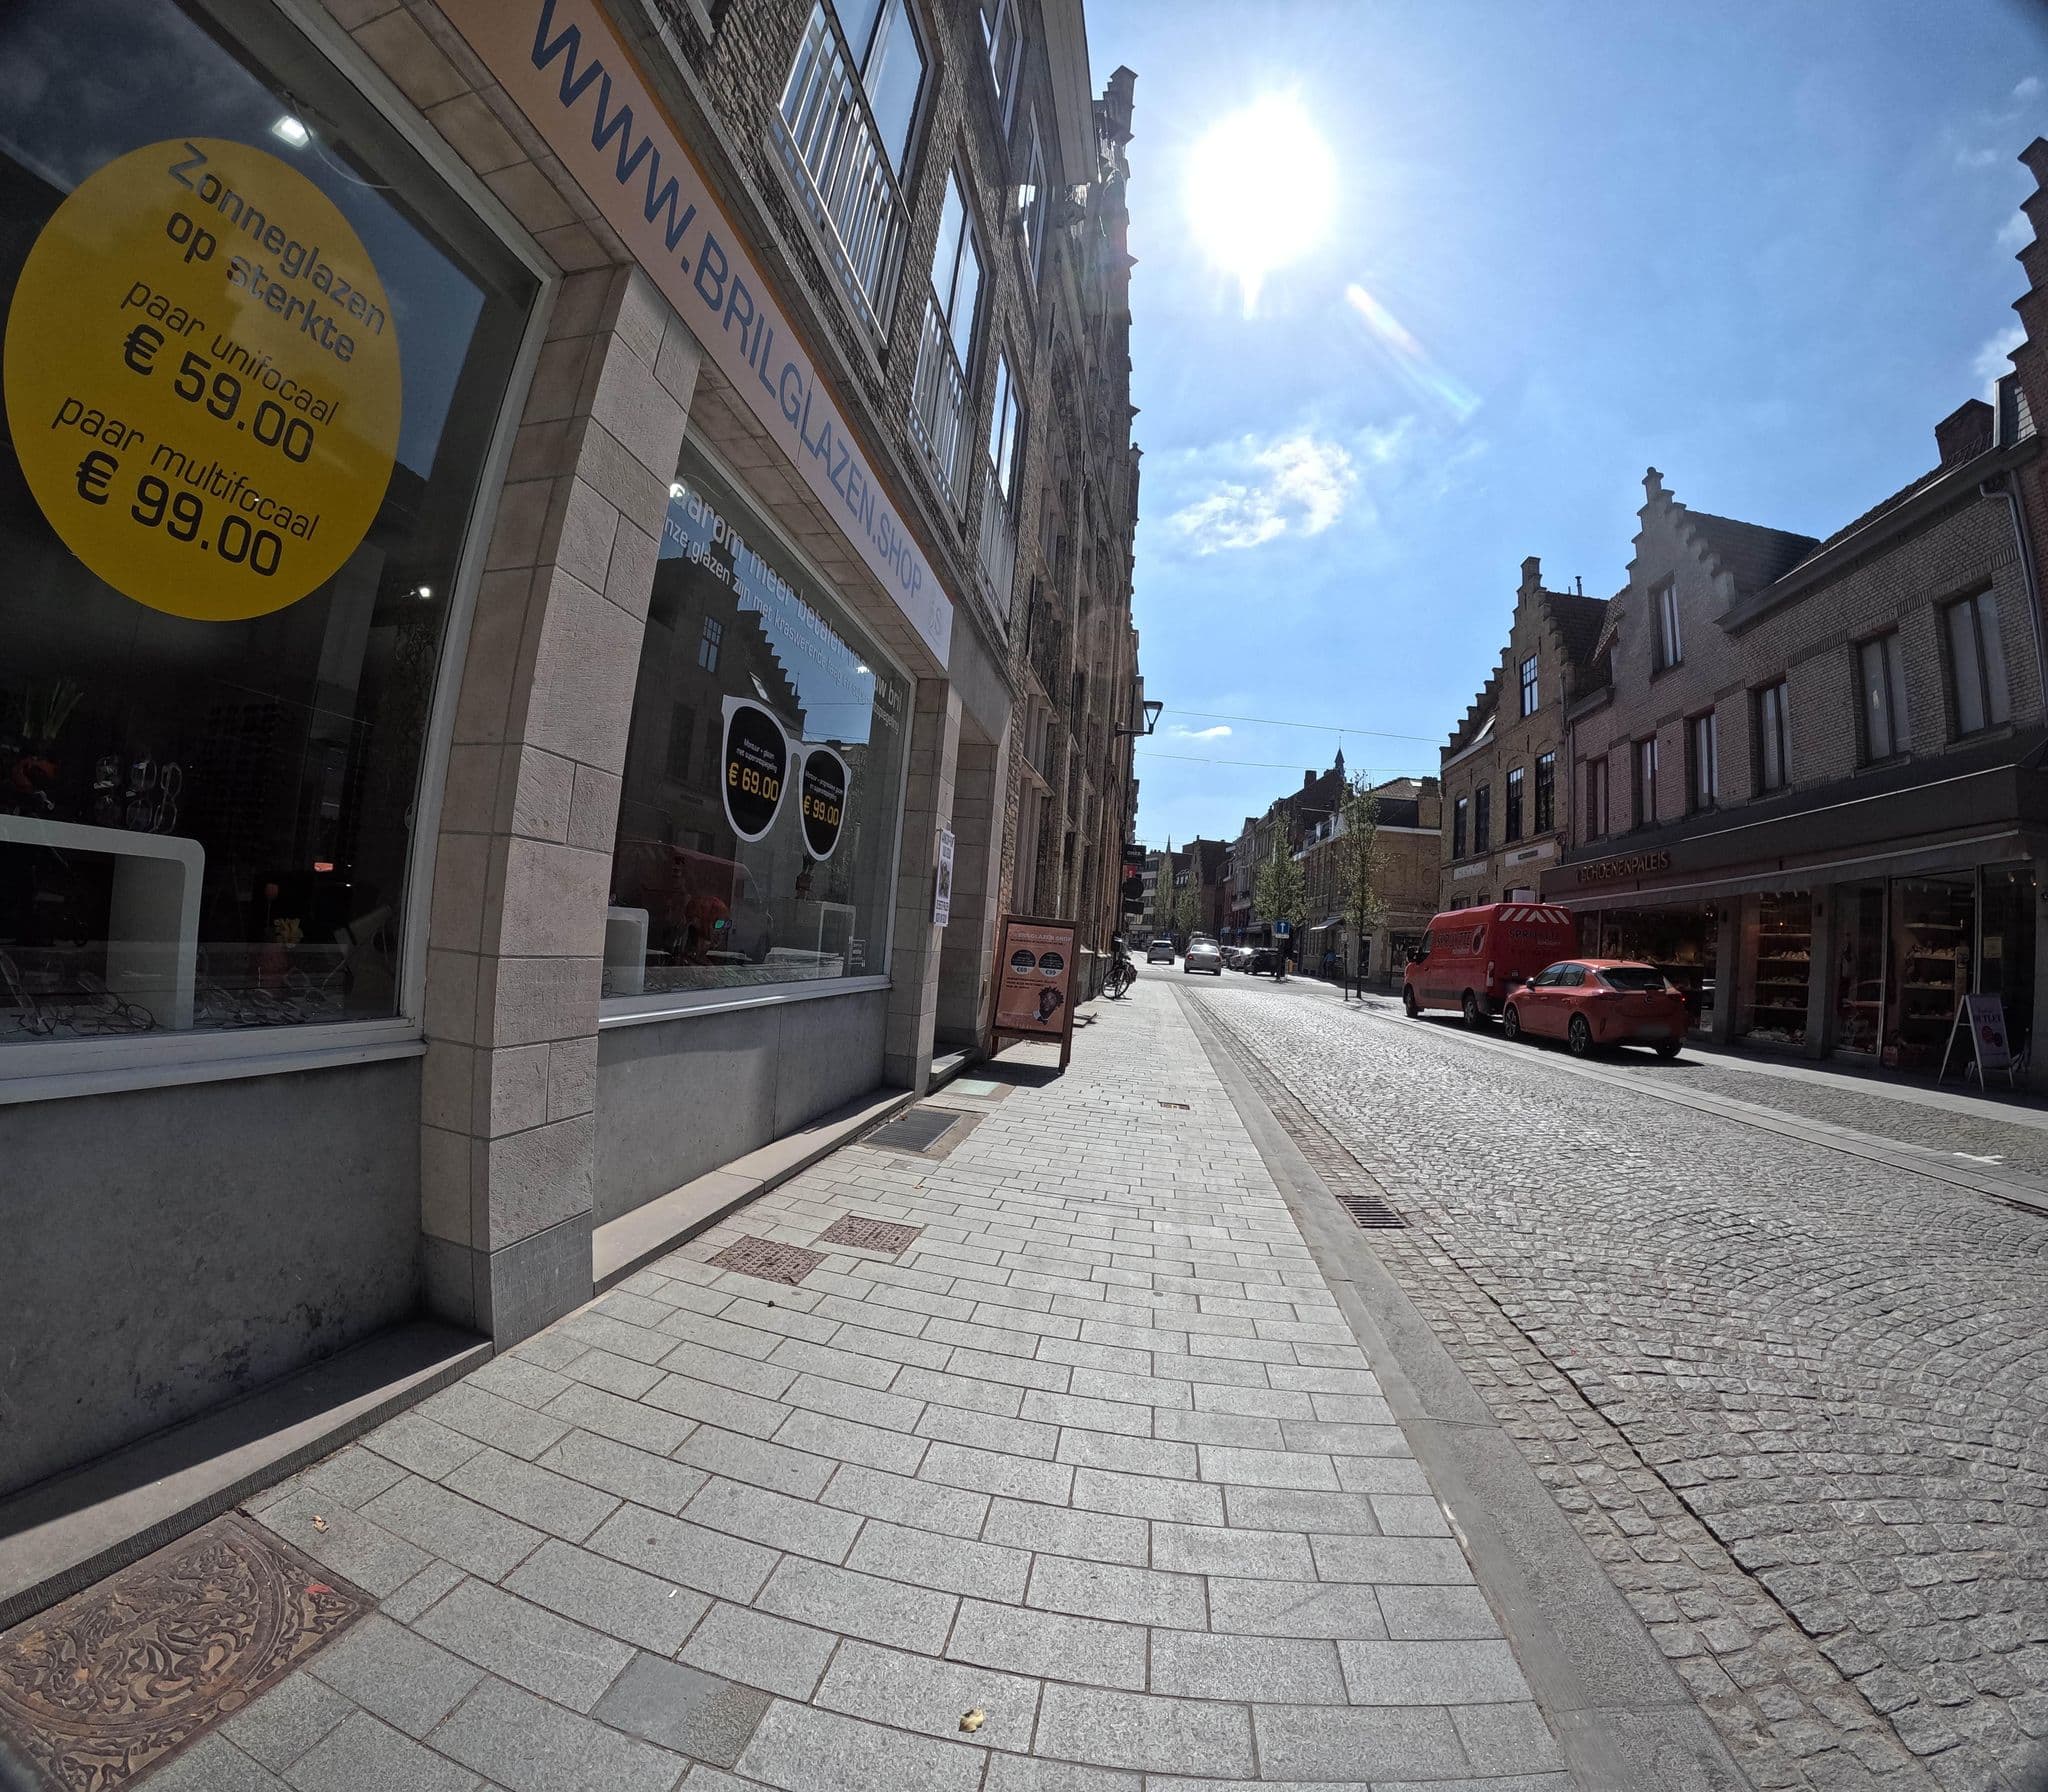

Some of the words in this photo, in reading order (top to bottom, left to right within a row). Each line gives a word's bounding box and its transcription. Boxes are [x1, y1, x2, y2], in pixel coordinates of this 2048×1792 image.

[166, 211, 217, 264] op
[226, 255, 356, 362] sterkte
[167, 141, 385, 336] Zonneglazen
[120, 280, 204, 338] paar
[210, 330, 340, 426] unifocaal
[122, 323, 165, 376] €
[174, 350, 315, 463] 59.00
[51, 396, 144, 453] paar
[150, 441, 320, 541] multifocaal
[75, 450, 119, 505] €
[131, 475, 283, 578] 99.00
[665, 516, 689, 548] nze
[690, 541, 730, 586] glazen
[732, 576, 751, 602] zijn
[753, 594, 773, 621] met
[749, 551, 794, 606] meer
[797, 588, 845, 658] betalen
[728, 762, 739, 787] €
[742, 767, 779, 801] 69.00
[803, 794, 812, 816] €
[813, 799, 840, 827] 99.00
